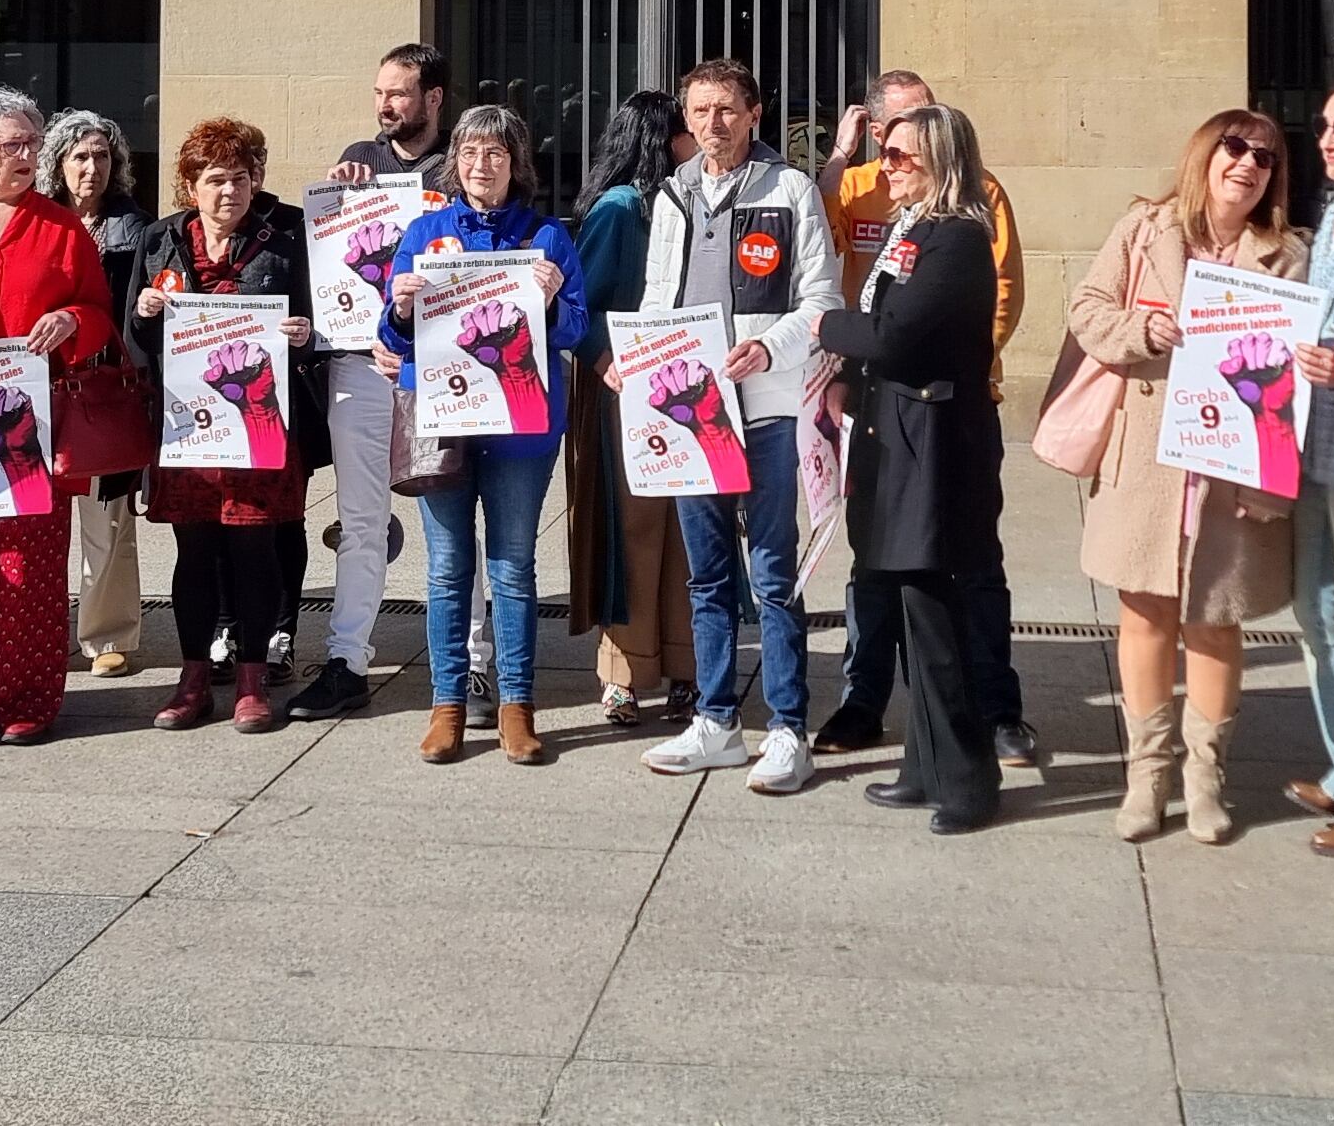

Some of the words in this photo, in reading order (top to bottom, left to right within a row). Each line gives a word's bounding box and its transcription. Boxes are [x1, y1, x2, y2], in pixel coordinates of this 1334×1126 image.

[313, 211, 341, 226] Mejora
[342, 206, 353, 215] de
[354, 193, 389, 210] nuestras
[423, 201, 444, 211] AB
[314, 216, 360, 240] condiciones
[361, 203, 400, 222] laborales
[742, 243, 775, 259] LAB
[317, 278, 356, 298] Greba
[423, 291, 455, 306] Mejora
[456, 285, 467, 295] de
[469, 271, 508, 291] nuestras
[338, 292, 353, 312] 9
[422, 295, 476, 320] condiciones
[478, 282, 519, 301] laborales
[1191, 306, 1226, 319] Mejora
[1229, 306, 1240, 315] de
[1243, 304, 1282, 314] nuestras
[173, 329, 202, 341] Mejora
[204, 324, 214, 333] de
[216, 314, 253, 330] nuestras
[327, 310, 371, 332] Huelga
[1187, 320, 1247, 335] condiciones
[1250, 318, 1292, 329] laborales
[171, 335, 223, 355] condiciones
[224, 324, 265, 340] laborales
[640, 346, 650, 355] de
[651, 329, 688, 349] nuestras
[661, 339, 701, 361] laborales
[423, 361, 472, 382] Greba
[449, 375, 468, 396] 9
[1175, 388, 1229, 405] Greba
[171, 395, 218, 414] Greba
[434, 394, 488, 417] Huelga
[195, 409, 212, 429] 9
[1201, 405, 1219, 429] 9
[179, 426, 231, 448] Huelga
[627, 420, 668, 442] Greba
[1180, 430, 1240, 448] Huelga
[648, 435, 668, 456] 9
[639, 451, 690, 477] Huelga
